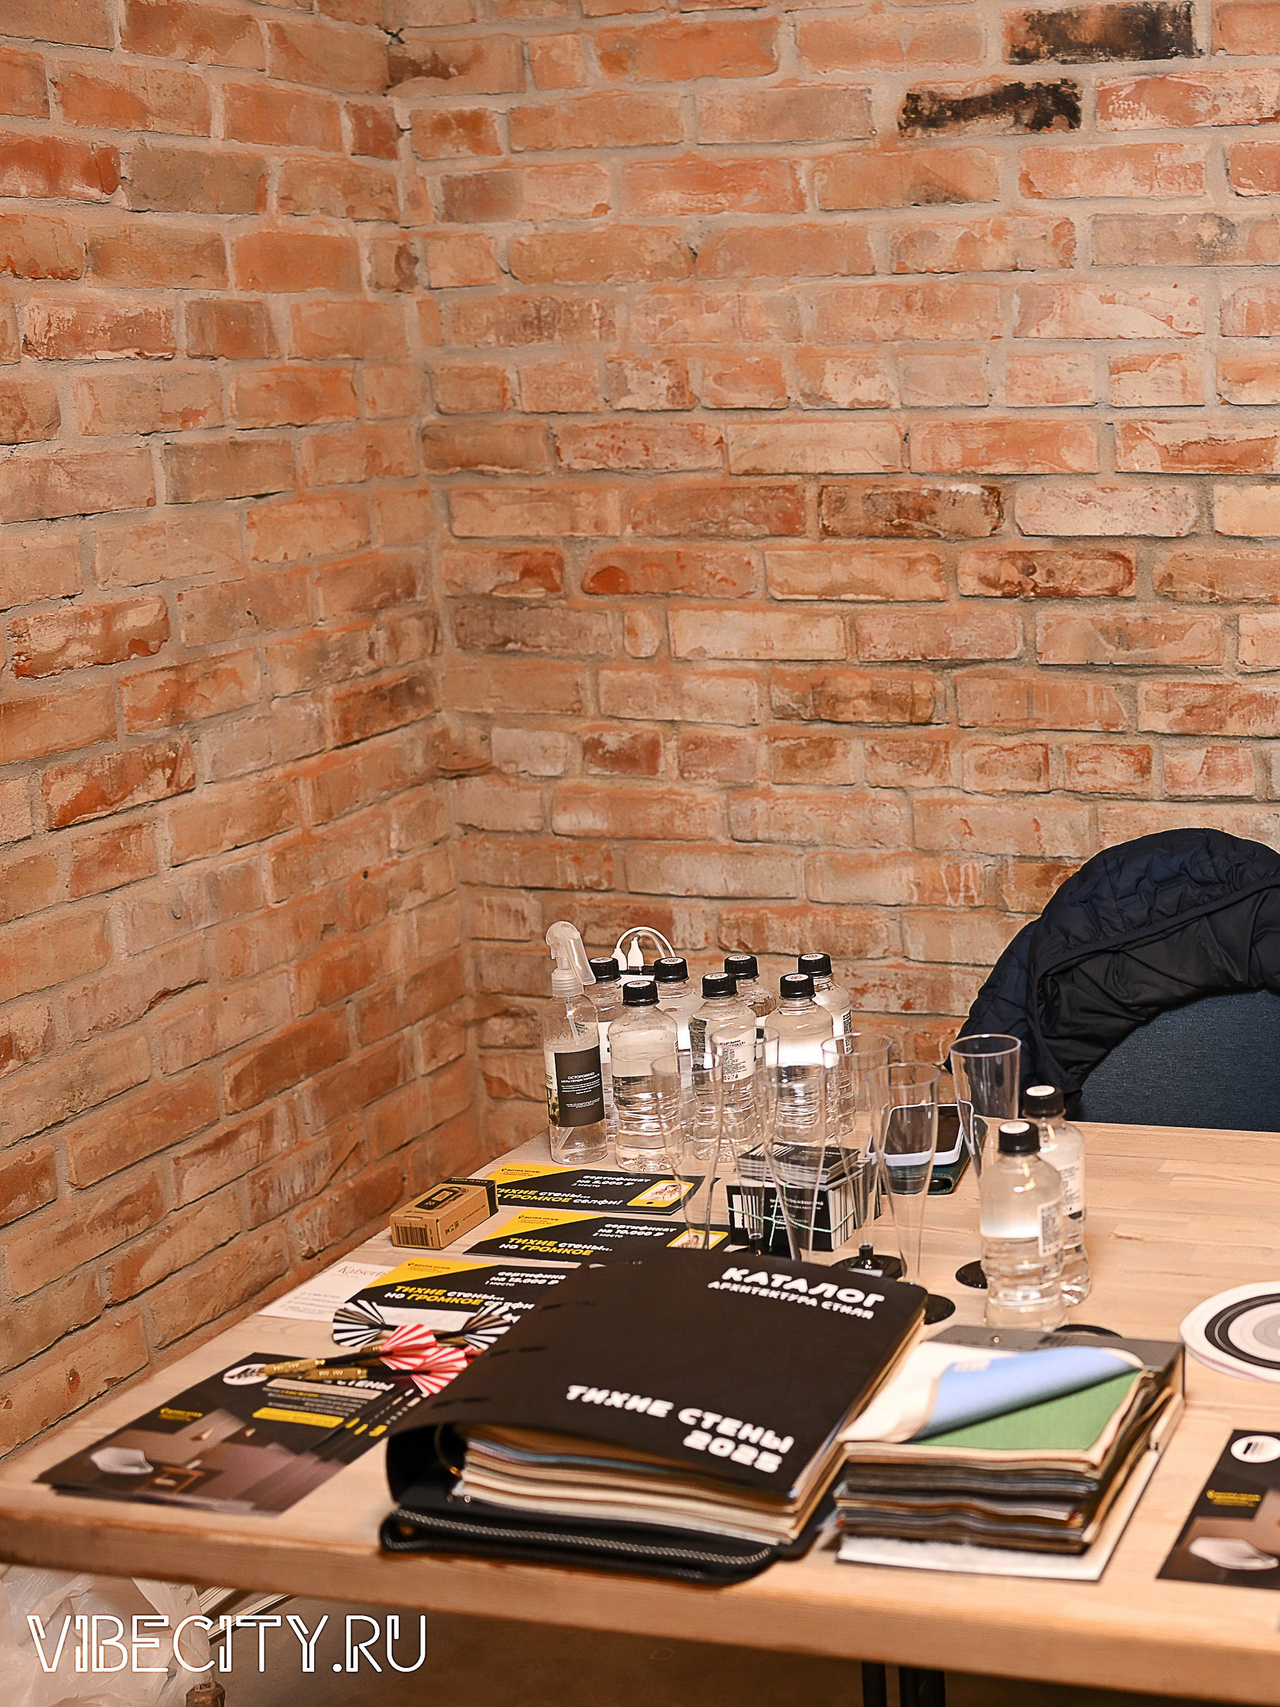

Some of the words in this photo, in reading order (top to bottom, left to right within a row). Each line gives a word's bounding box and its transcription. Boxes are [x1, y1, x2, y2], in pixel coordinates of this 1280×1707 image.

[503, 1194, 571, 1204] ГРОМКОЕ
[508, 1237, 558, 1247] ТИХИЕ
[520, 1245, 594, 1257] ГРОМКОЕ
[497, 1271, 567, 1280] сертифика
[395, 1285, 448, 1296] ТИХИЕ
[721, 1267, 885, 1308] КАТАЛОГ
[384, 1291, 406, 1299] но
[406, 1293, 484, 1306] ГРОМКОЕ
[707, 1281, 818, 1308] АРХИТЕКТУРА
[821, 1300, 875, 1320] СТИЛЯ
[566, 1384, 675, 1419] ТИХИЕ
[678, 1407, 794, 1454] СТЕНЫ
[683, 1429, 782, 1473] 2025
